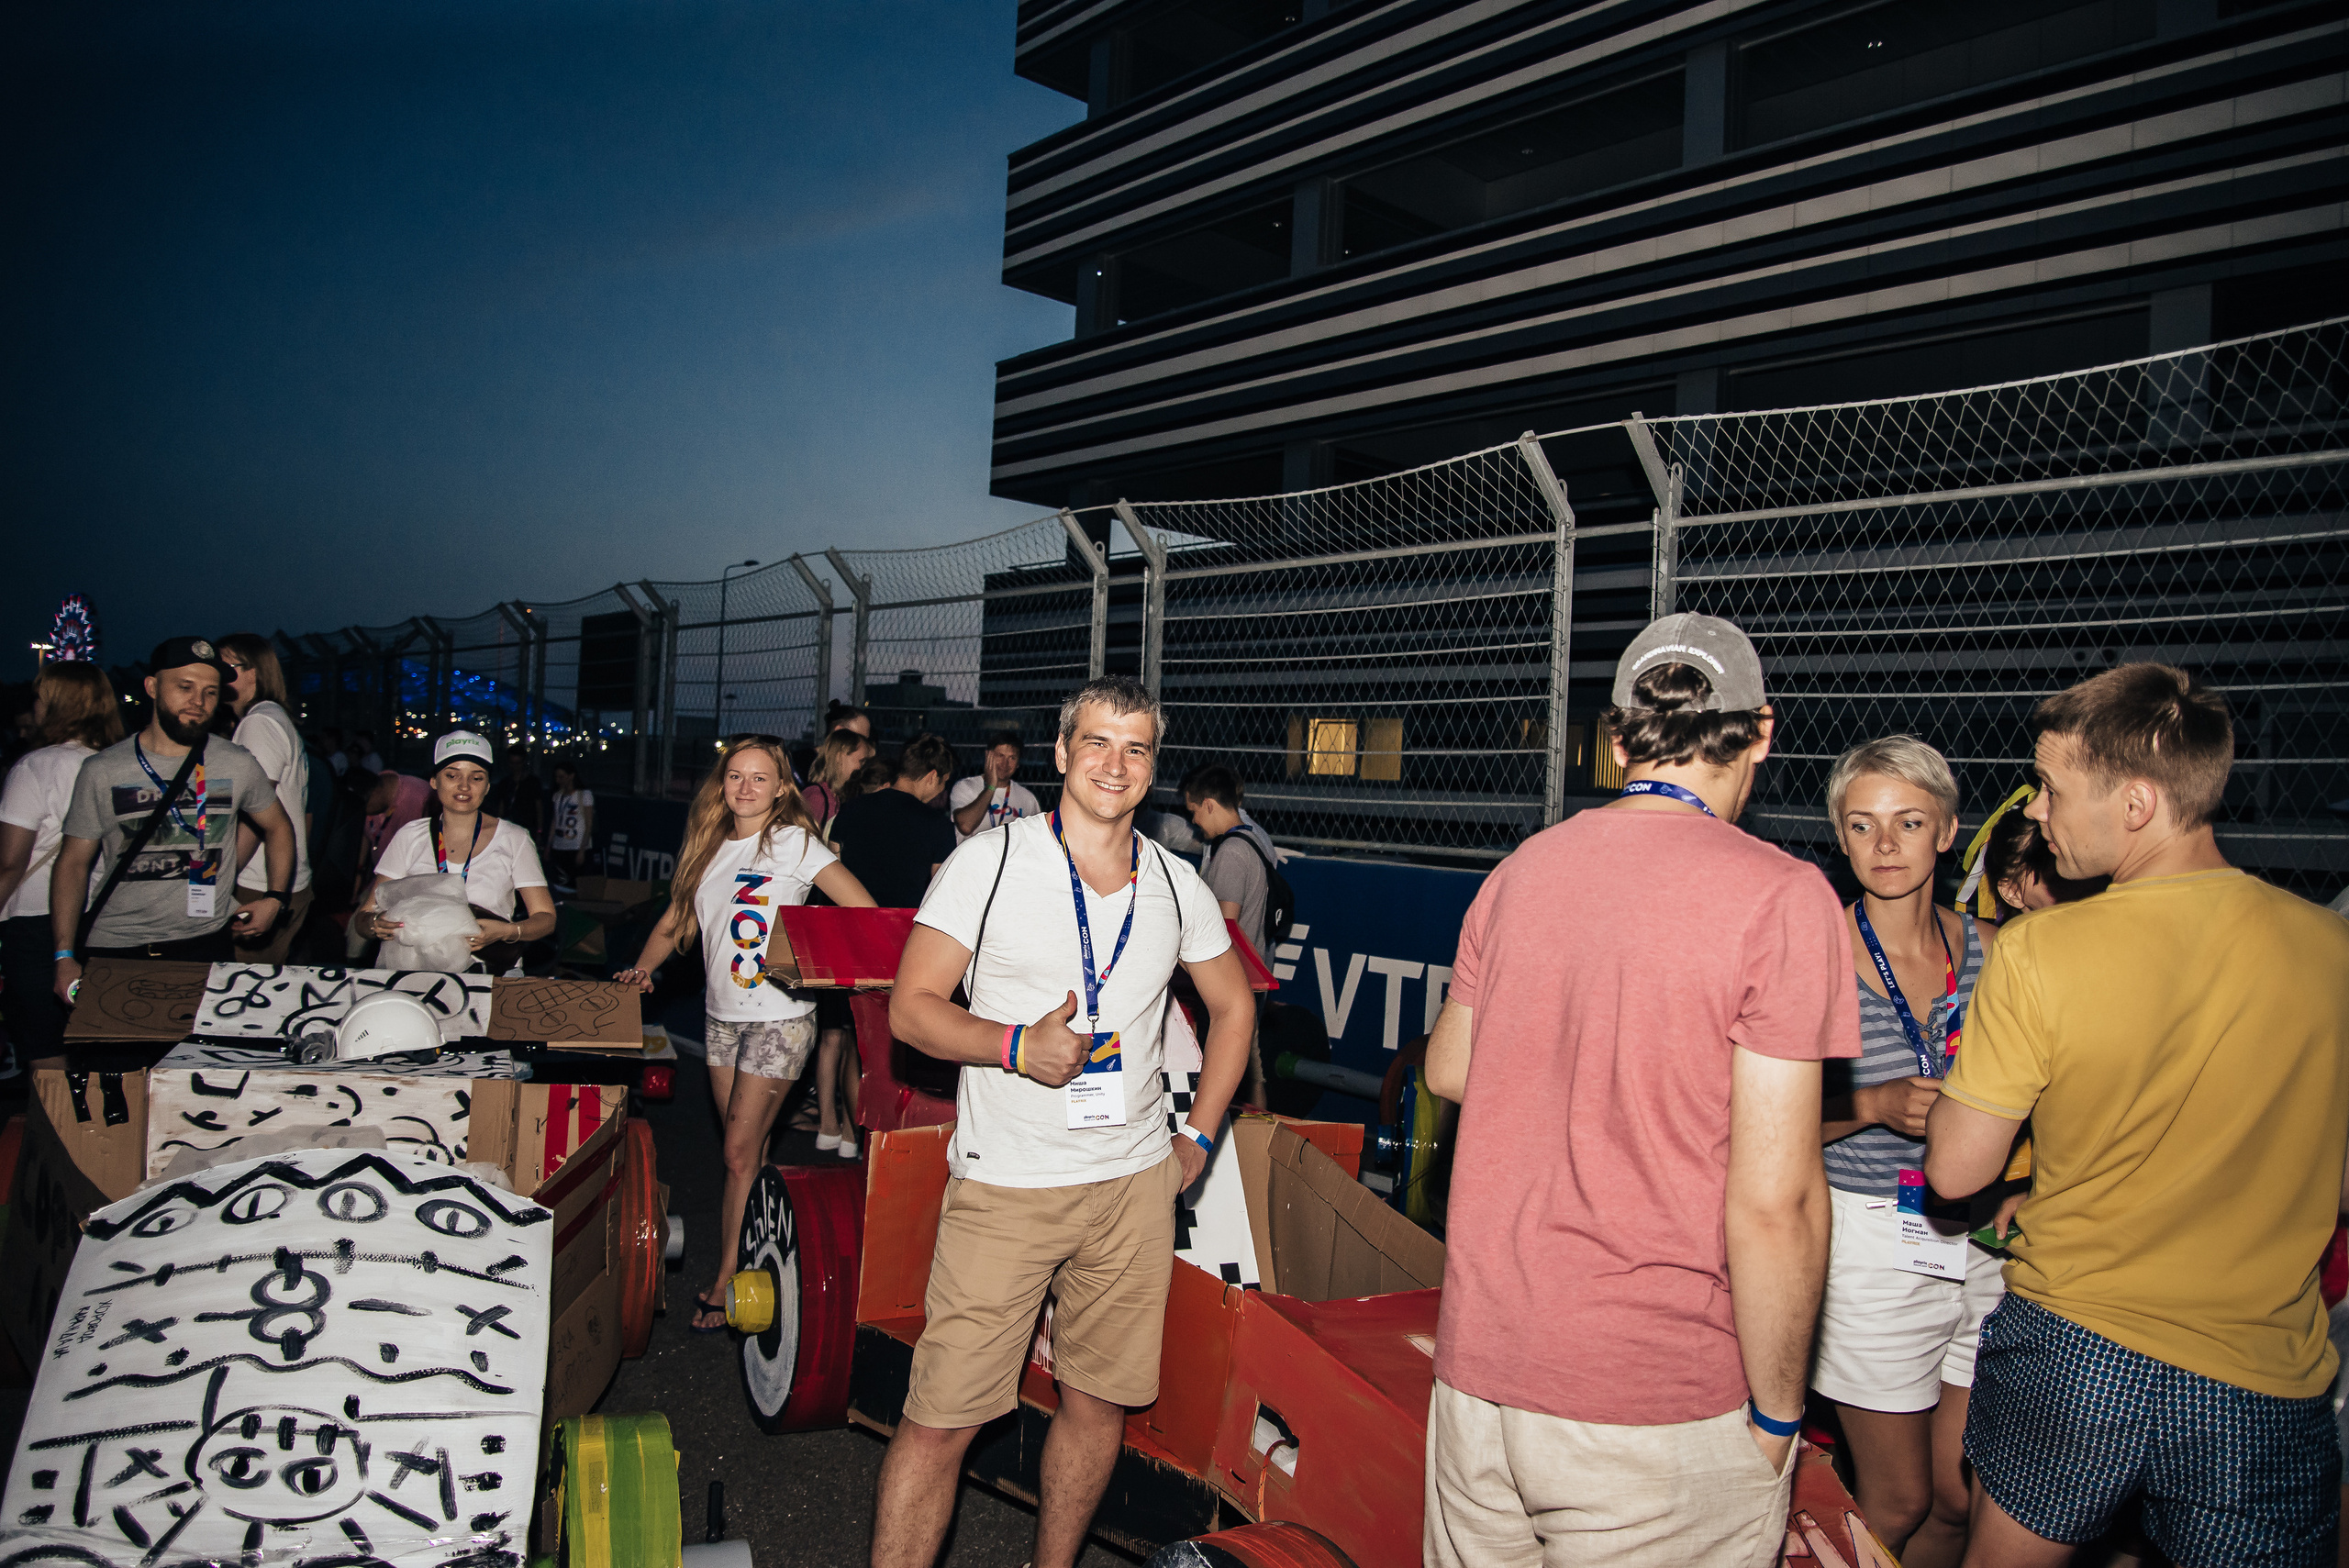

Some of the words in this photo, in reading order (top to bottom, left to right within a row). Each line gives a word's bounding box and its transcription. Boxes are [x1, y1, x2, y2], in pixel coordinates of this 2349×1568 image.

[446, 739, 480, 749] playrix
[1629, 783, 1653, 793] CON
[729, 873, 773, 989] CON
[1081, 926, 1089, 944] CON
[1874, 951, 1887, 971] PLAY!
[1882, 971, 1896, 989] LET'S
[1920, 1054, 1931, 1075] CON
[1902, 1219, 1923, 1228] Маша
[1928, 1262, 1945, 1271] CON
